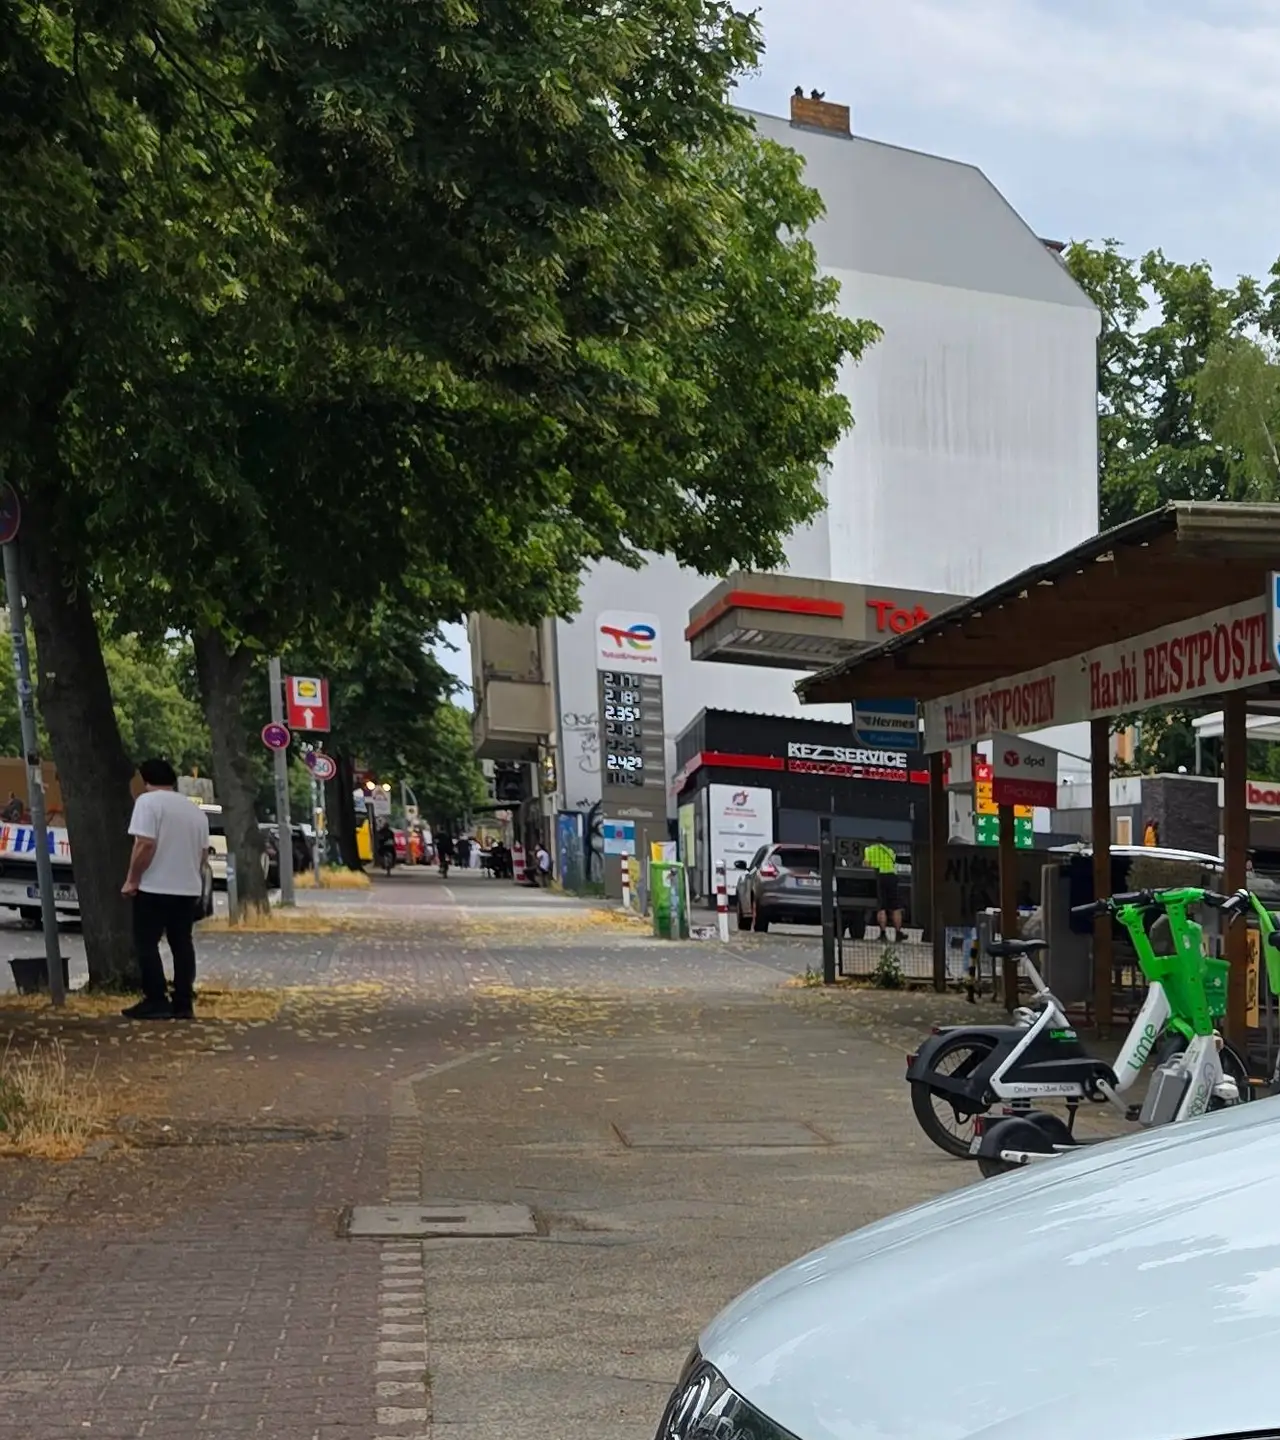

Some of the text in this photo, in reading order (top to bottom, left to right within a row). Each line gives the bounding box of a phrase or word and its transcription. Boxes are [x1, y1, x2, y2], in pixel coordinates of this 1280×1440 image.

[1090, 651, 1138, 711] Harbi
[872, 715, 915, 729] Hermes
[974, 675, 1056, 735] RESTPOSTEN
[834, 746, 908, 768] SERVICE
[1023, 754, 1046, 768] dpd
[1127, 1023, 1158, 1071] Lime
